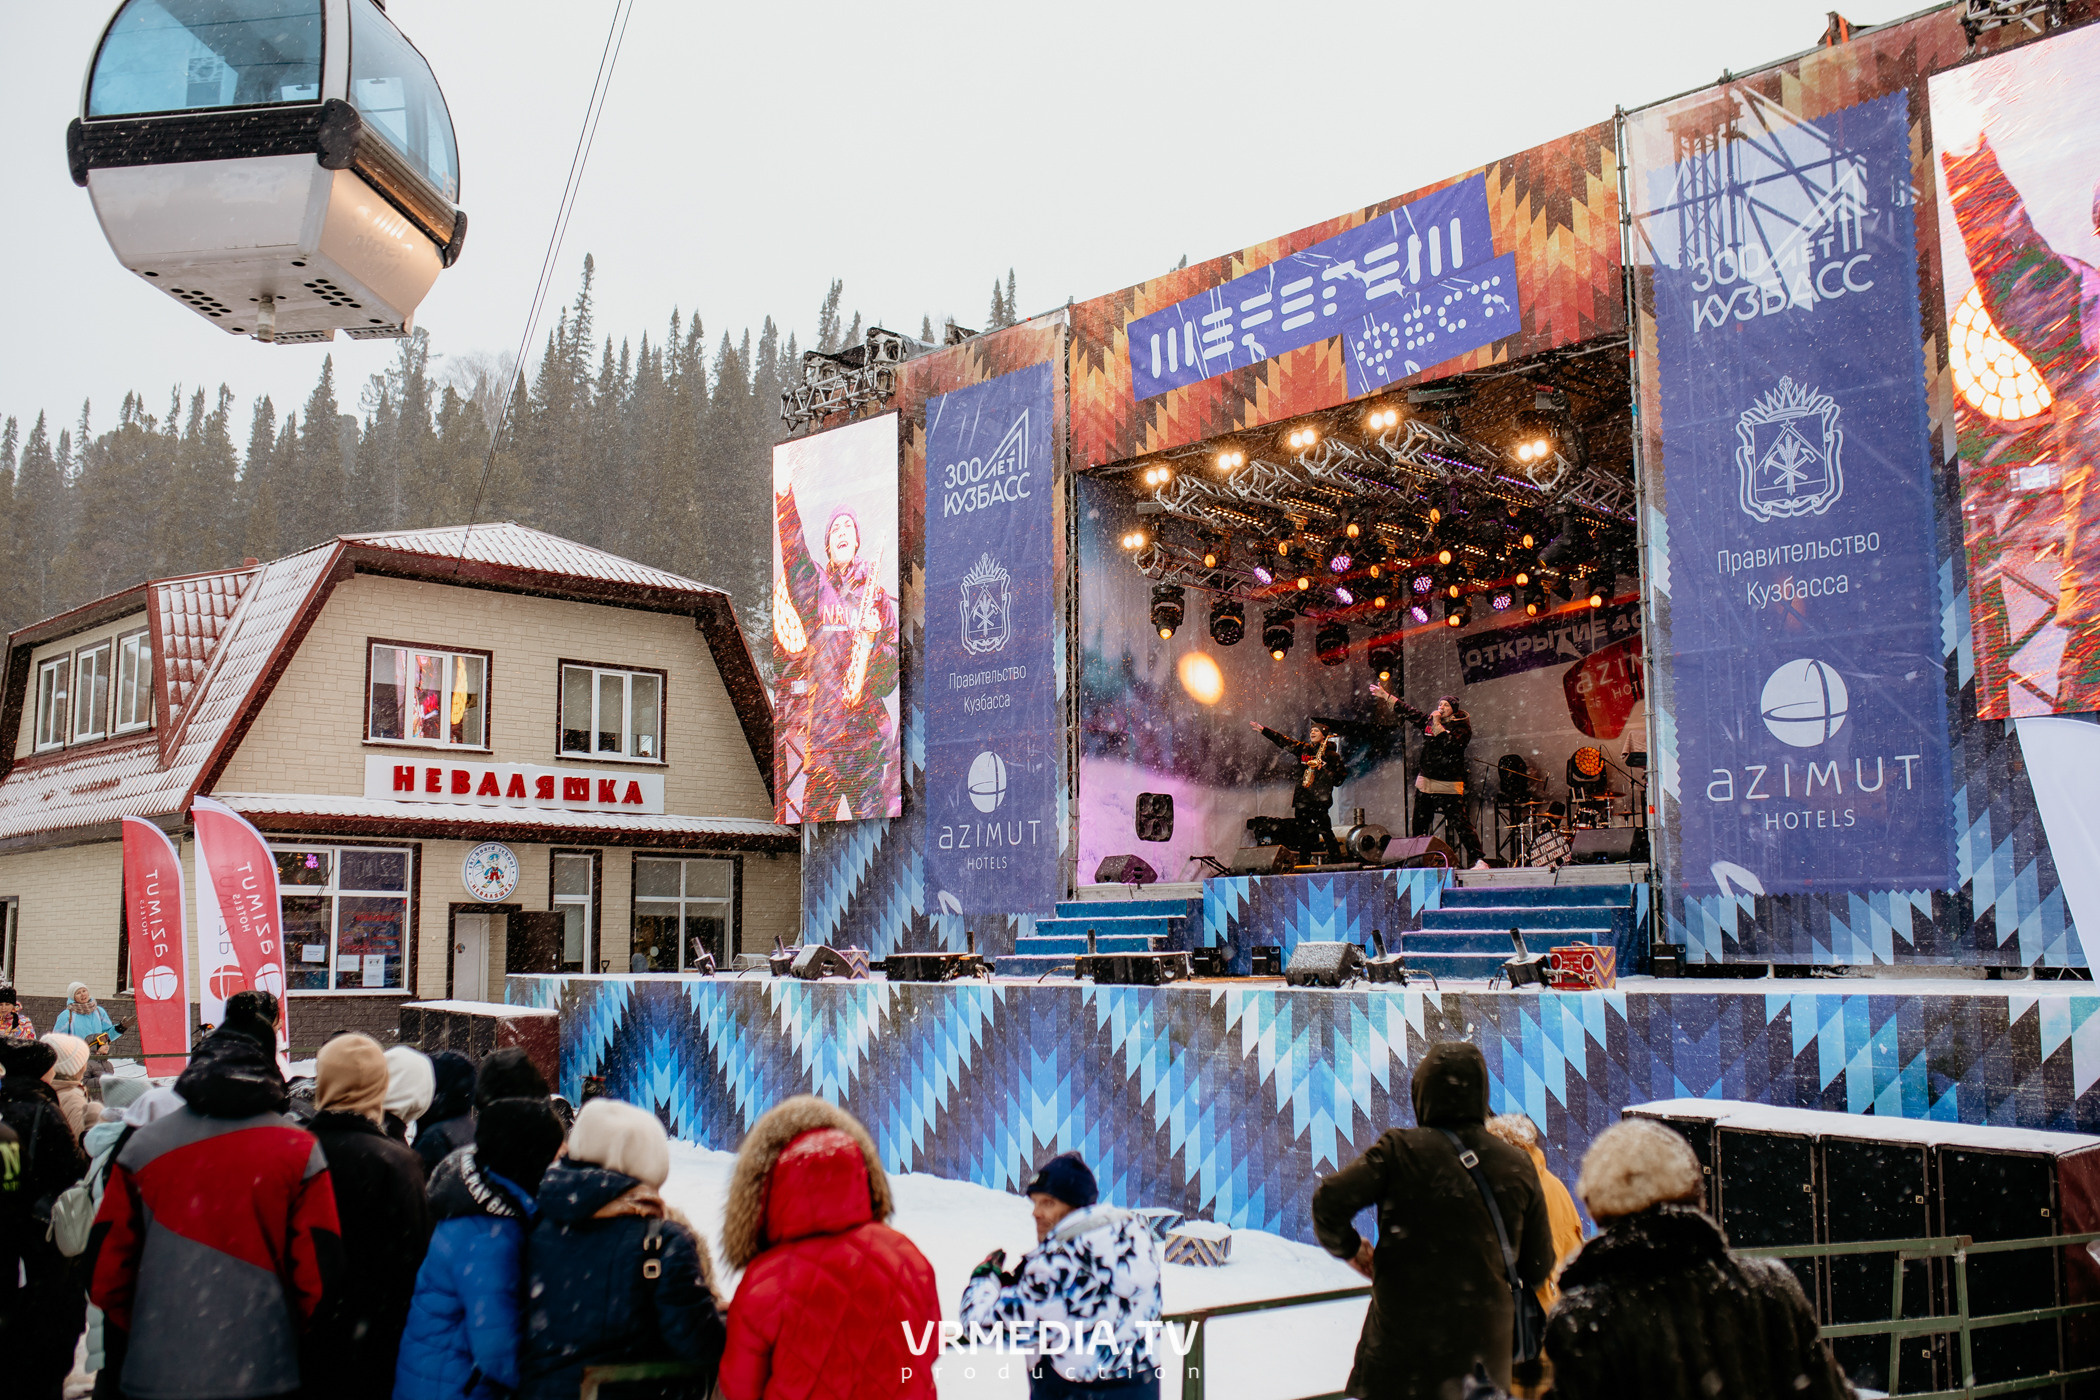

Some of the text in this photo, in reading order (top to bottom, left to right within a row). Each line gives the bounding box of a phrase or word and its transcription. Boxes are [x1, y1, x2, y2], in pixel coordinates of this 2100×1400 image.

[1691, 242, 1765, 292] 300
[1692, 254, 1875, 334] КУЗБАСС
[944, 457, 981, 489] 300
[943, 472, 1031, 518] КУЗБАСС
[1717, 532, 1881, 576] Правительство
[1747, 575, 1849, 610] Кузбасса
[1465, 619, 1608, 667] ОТКРЫТИЕ
[949, 665, 1027, 691] Правительство
[964, 694, 1011, 716] Кузбасса
[393, 765, 643, 805] НЕВАЛЯШКА
[1765, 809, 1856, 831] HOTELS
[967, 856, 1008, 870] HOTELS
[465, 1171, 492, 1204] PLAY
